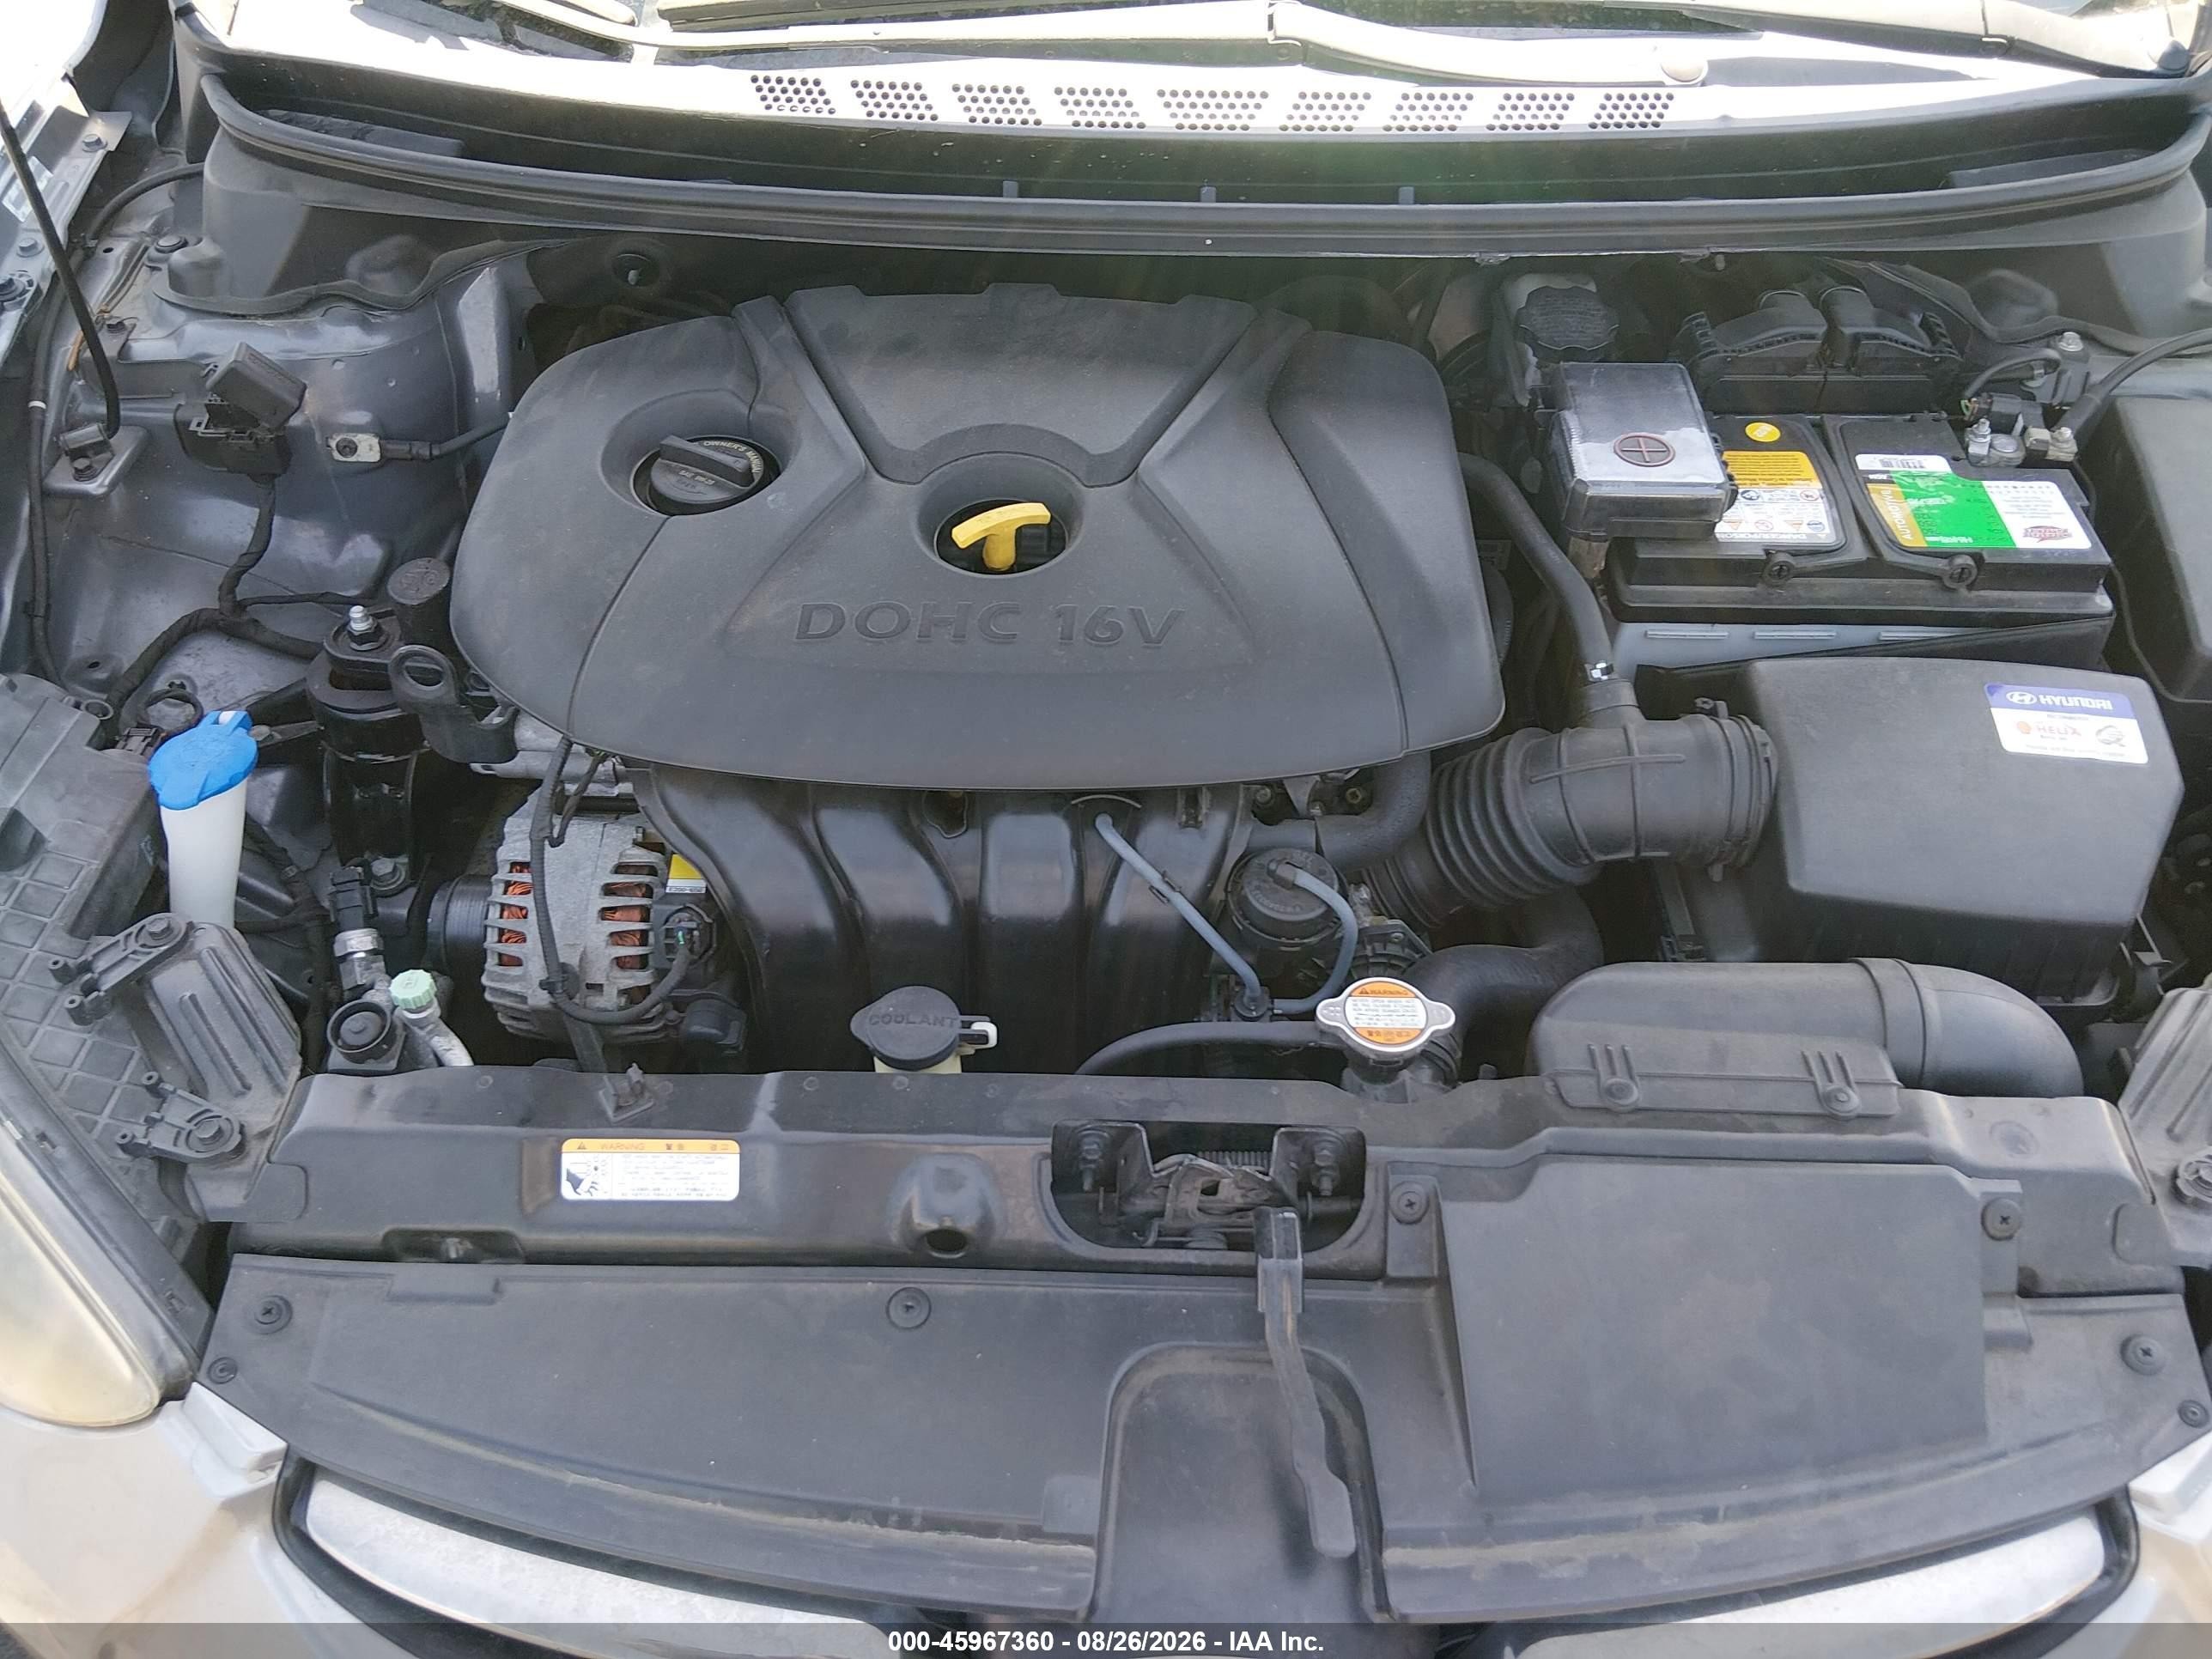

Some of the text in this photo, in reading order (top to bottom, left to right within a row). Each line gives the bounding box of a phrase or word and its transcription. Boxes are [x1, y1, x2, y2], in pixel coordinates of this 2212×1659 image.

[1881, 489, 1914, 540] AUTOMOTIVE
[793, 601, 1186, 647] DOHC 16V
[2038, 694, 2114, 711] HYUNDAI
[2035, 721, 2082, 737] HELIX
[868, 1013, 958, 1029] COOLANT
[600, 1141, 646, 1151] WARNING
